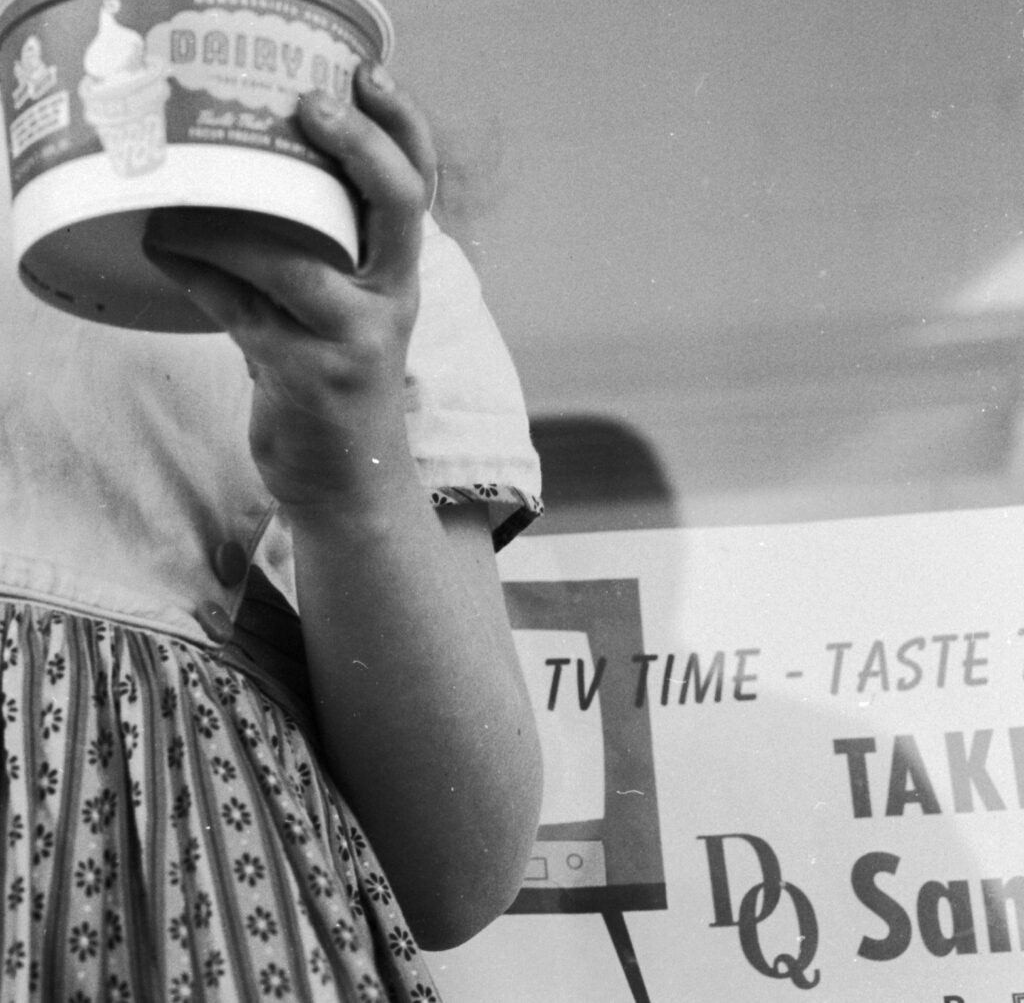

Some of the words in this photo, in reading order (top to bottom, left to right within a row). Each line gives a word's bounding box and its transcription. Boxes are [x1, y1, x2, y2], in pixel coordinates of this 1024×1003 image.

[170, 29, 304, 80] DAIRY
[545, 655, 607, 711] TV
[630, 648, 761, 708] TIME
[826, 631, 991, 696] TASTE
[850, 850, 1024, 962] San
